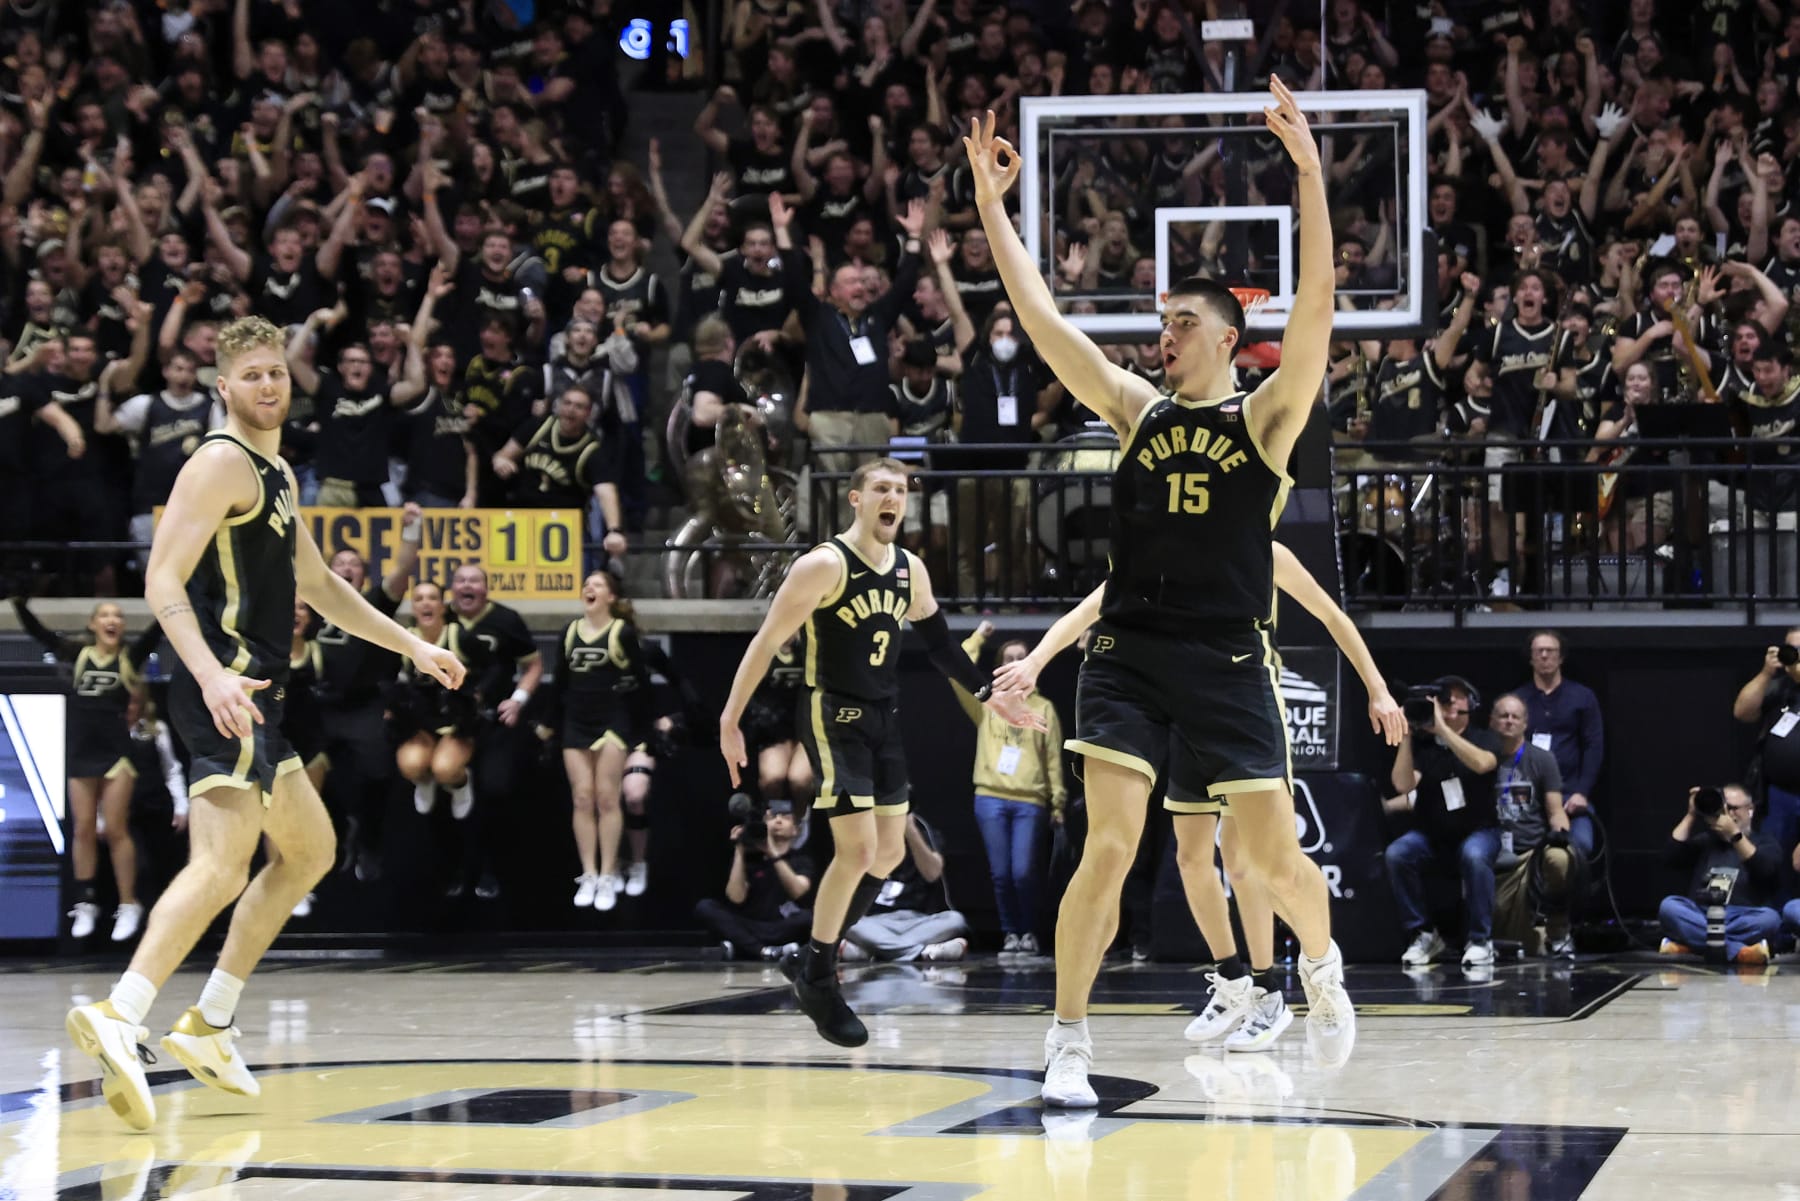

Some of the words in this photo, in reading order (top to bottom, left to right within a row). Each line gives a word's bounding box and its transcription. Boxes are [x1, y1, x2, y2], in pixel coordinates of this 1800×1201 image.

[1136, 425, 1248, 473] PURDUE
[1166, 472, 1210, 514] 15
[836, 588, 907, 629] PURDU
[568, 647, 609, 672] P
[869, 630, 891, 666] 3
[1092, 635, 1115, 653] P
[76, 670, 120, 697] P
